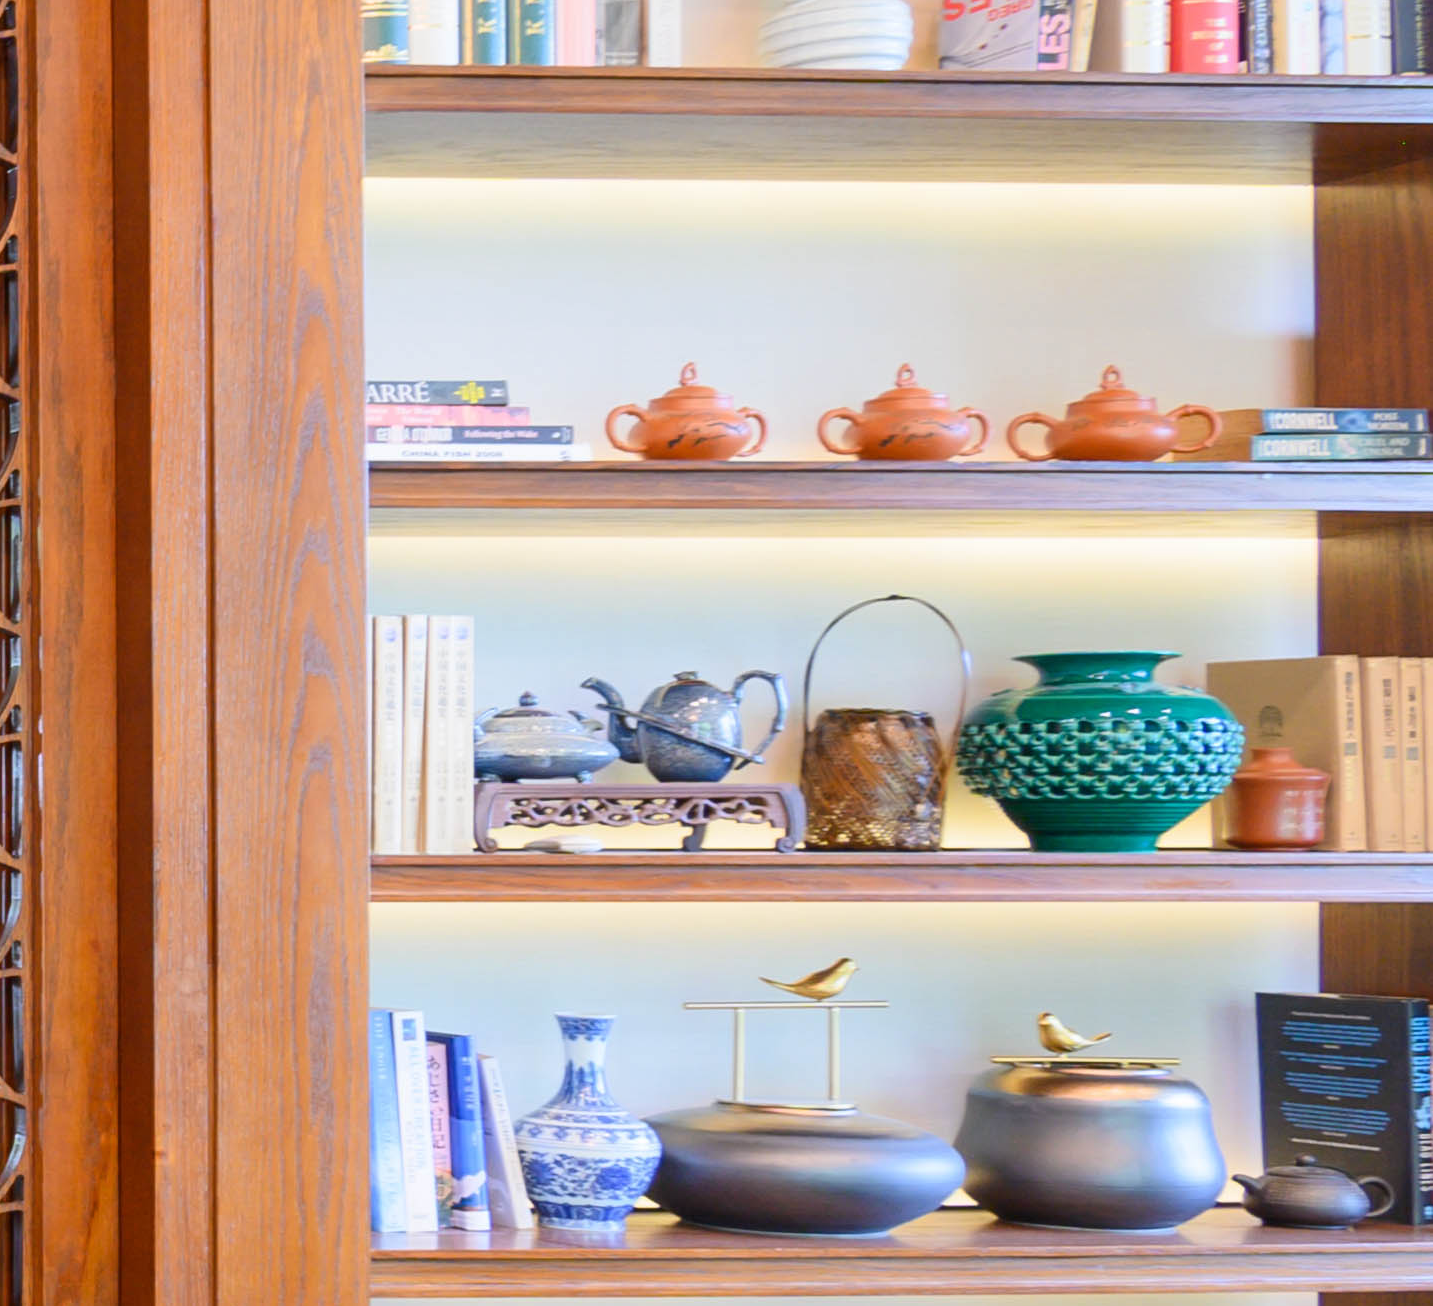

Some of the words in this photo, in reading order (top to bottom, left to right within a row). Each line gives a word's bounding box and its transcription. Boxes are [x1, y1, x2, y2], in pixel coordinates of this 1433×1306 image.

[1038, 13, 1071, 71] LES
[365, 380, 430, 403] ARRÉ
[1410, 1016, 1430, 1052] GREG
